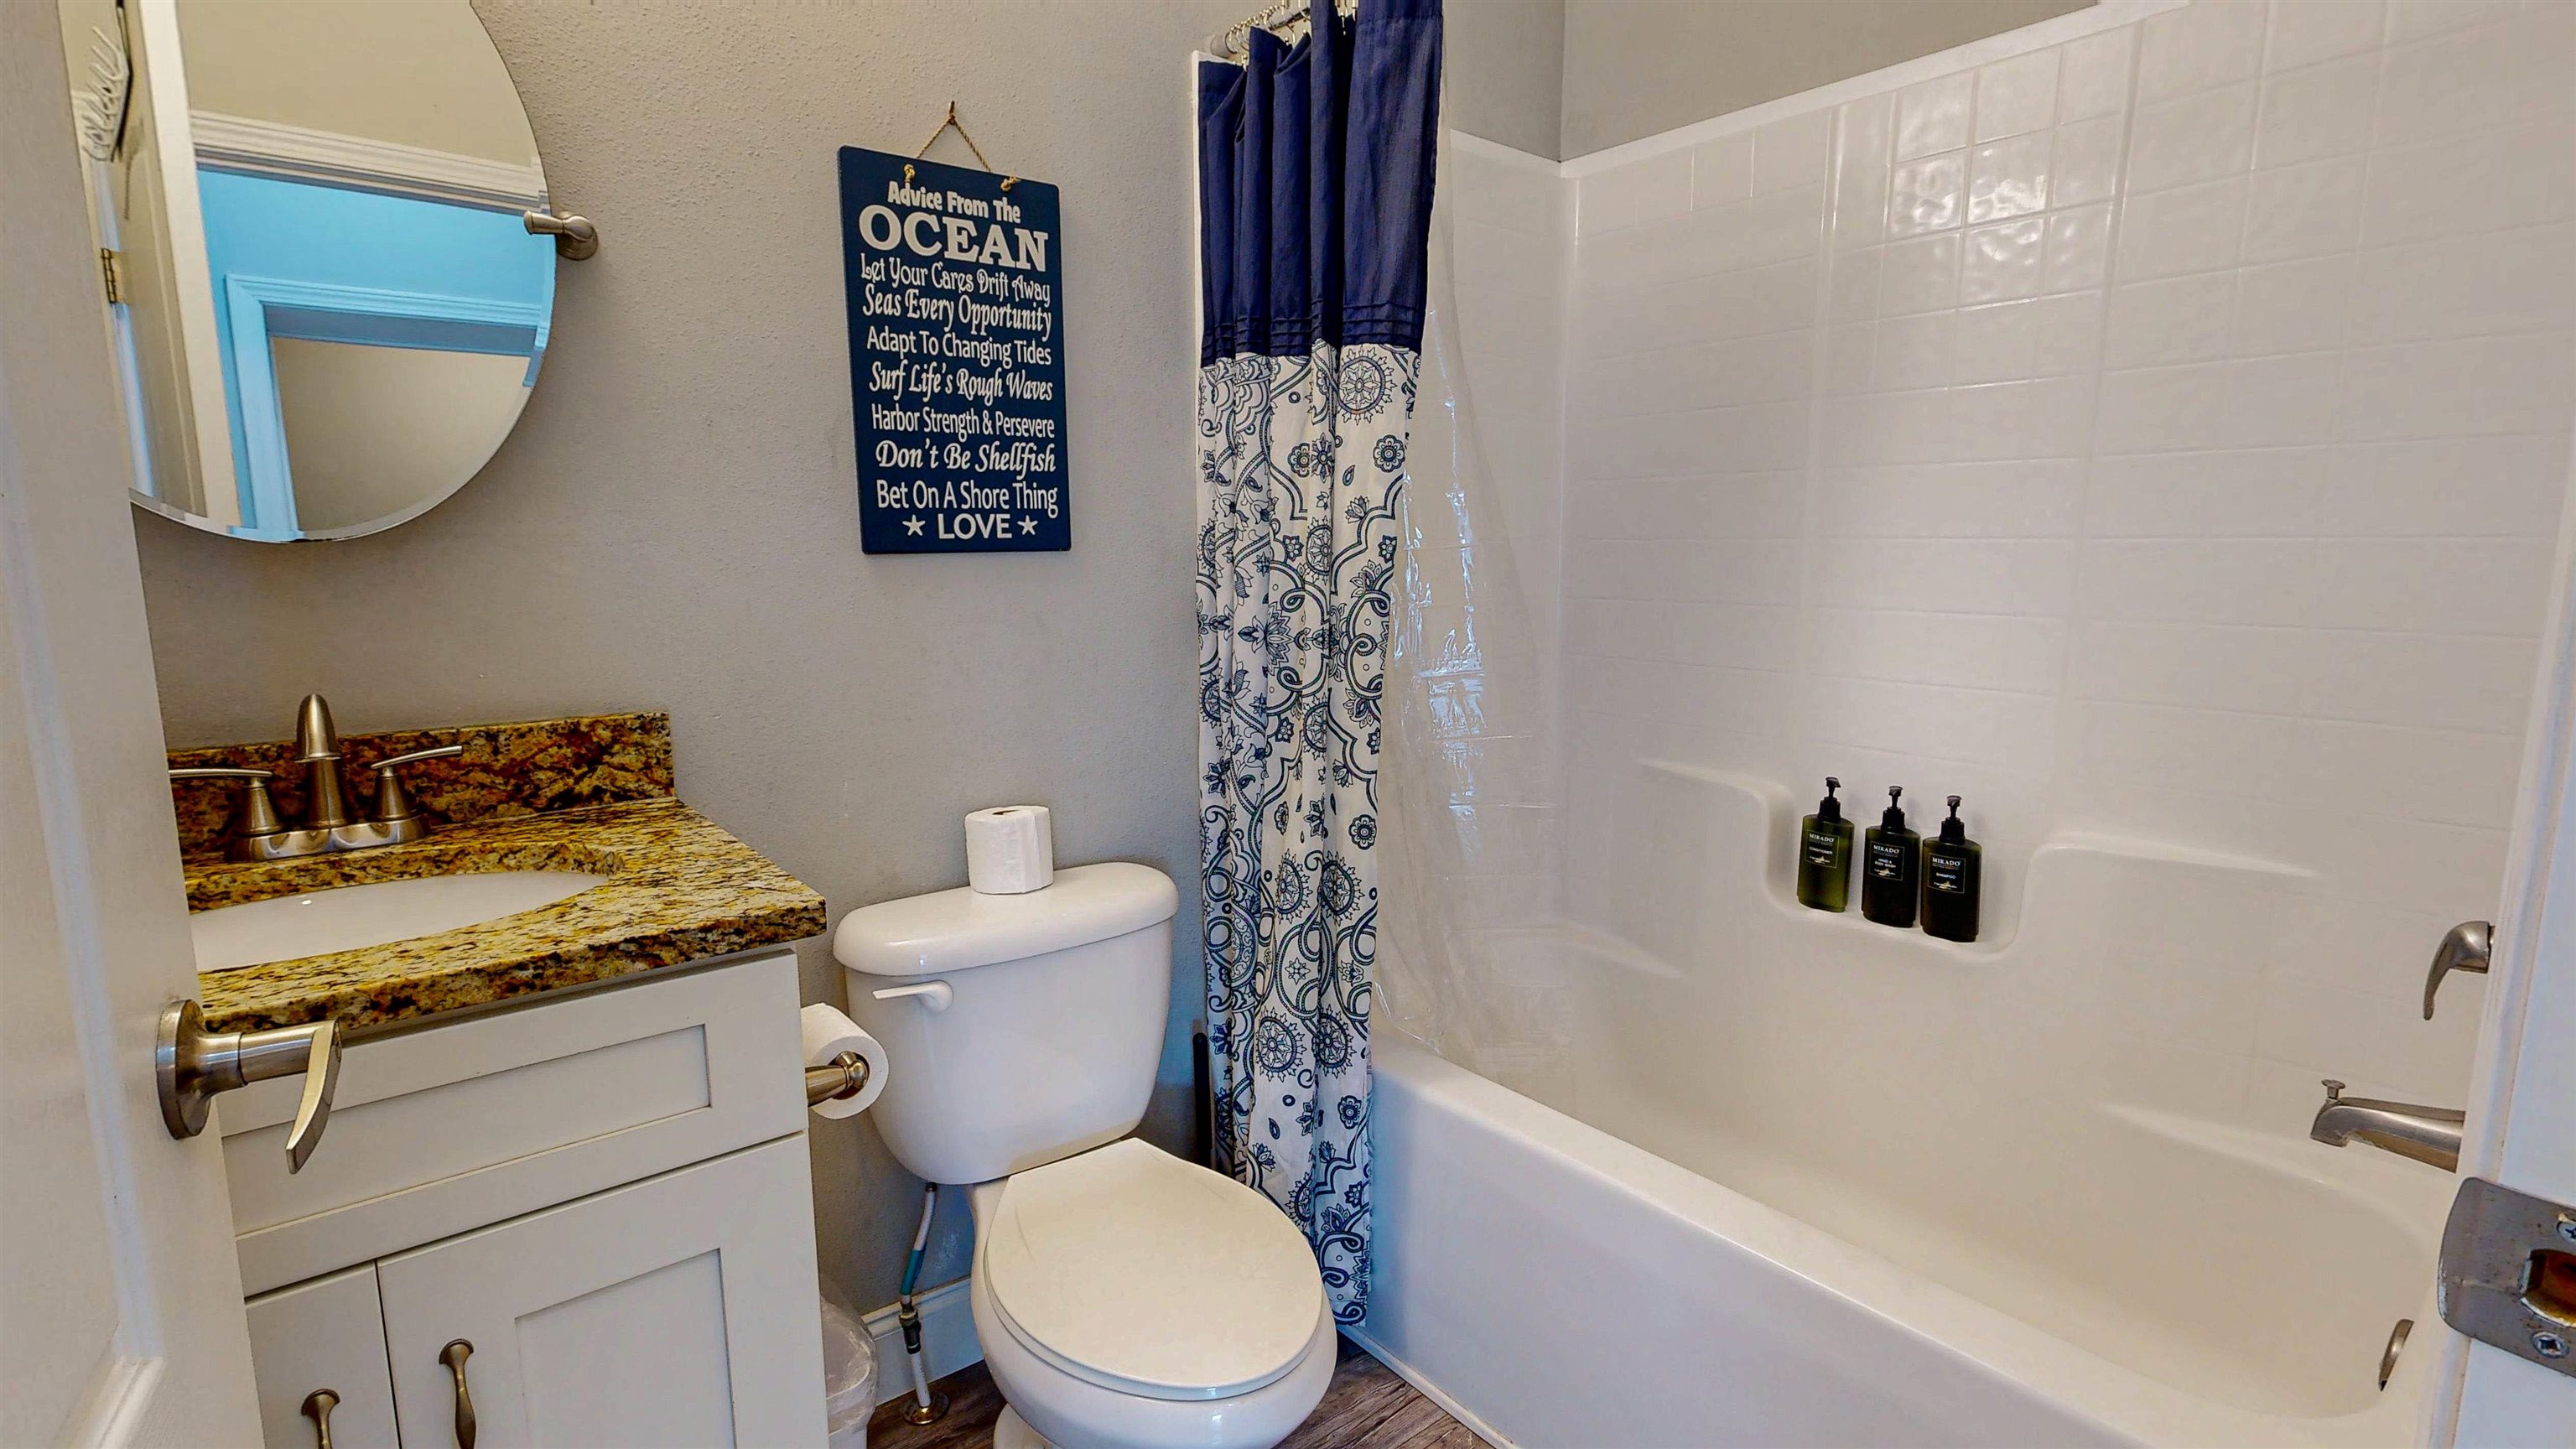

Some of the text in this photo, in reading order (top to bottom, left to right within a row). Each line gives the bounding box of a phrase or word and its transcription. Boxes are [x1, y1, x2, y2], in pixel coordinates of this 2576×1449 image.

[888, 181, 1021, 224] Advice From The
[859, 205, 1048, 272] OCEAN
[860, 253, 1050, 308] Let Your Cares Drift Away
[863, 283, 1051, 341] Seas Every Opportunity
[867, 325, 1052, 369] Adapt To Changing Tides
[870, 360, 1052, 406] Surf Life's Rough Waves
[871, 402, 1054, 442] Harbor Strength & Persevere
[875, 438, 1056, 480] Don't Be Shellfish
[876, 480, 1058, 518] Bet On A Shore Thing
[937, 513, 1012, 539] LOVE
[1809, 833, 1834, 843] MIKADO
[1873, 844, 1899, 854] MIKADO
[1932, 857, 1961, 866] MIKADO
